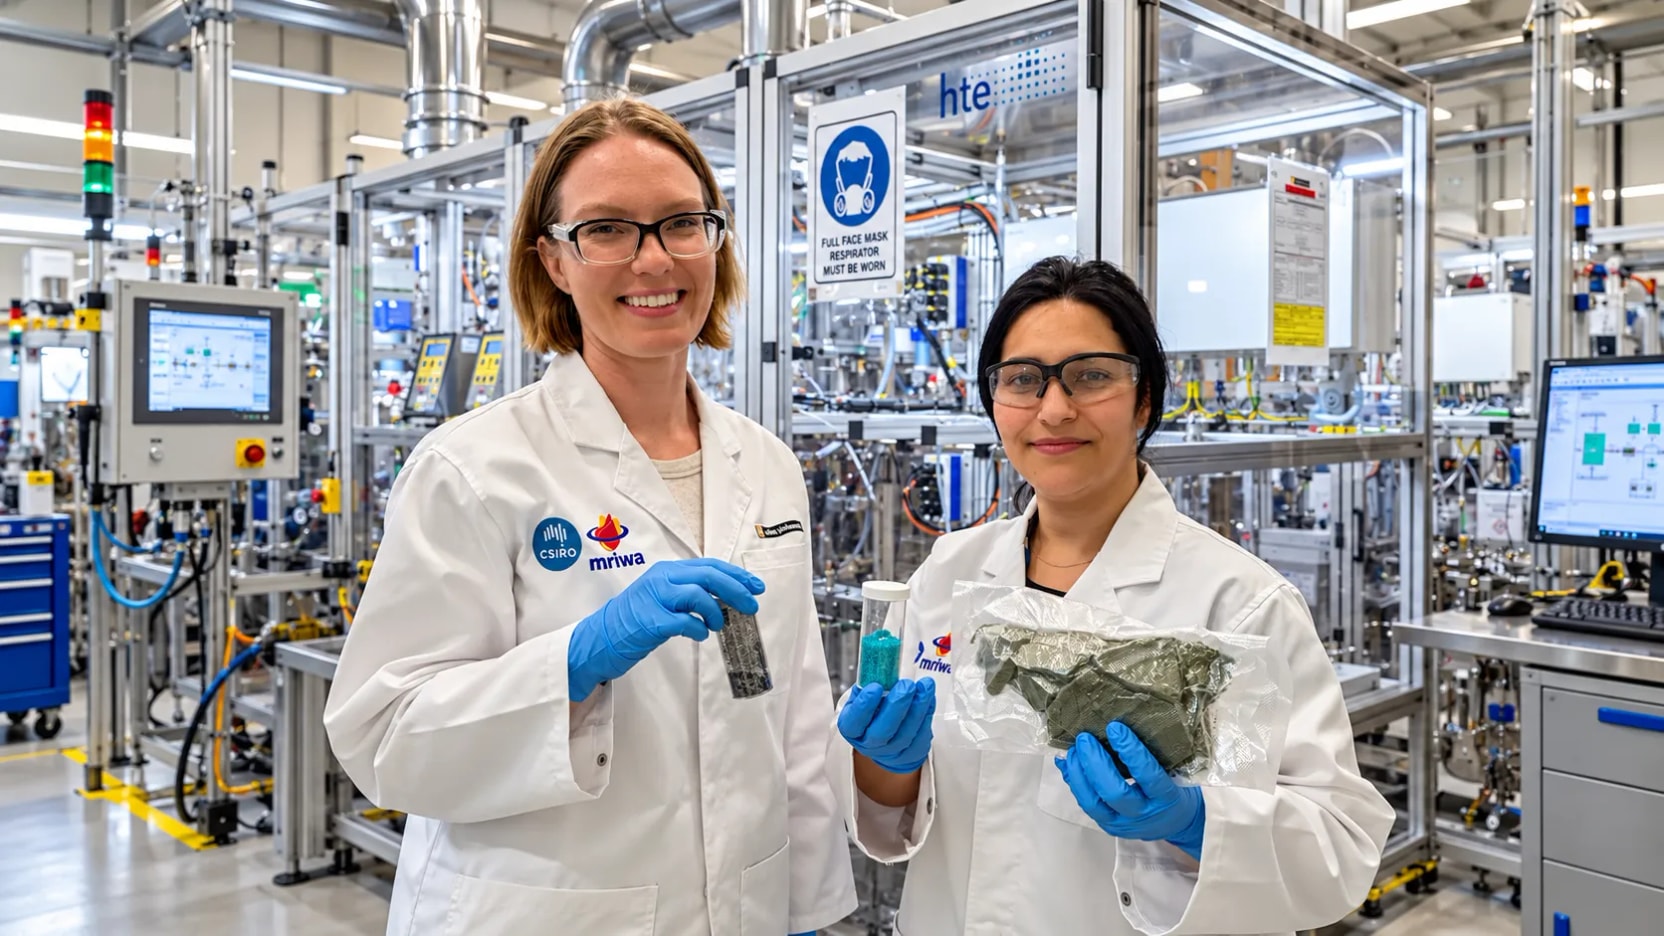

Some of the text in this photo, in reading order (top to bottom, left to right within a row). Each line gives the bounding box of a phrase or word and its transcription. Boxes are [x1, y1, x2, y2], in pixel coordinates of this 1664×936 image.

[940, 72, 991, 118] hte
[821, 231, 888, 248] FULL FACE MASK
[830, 246, 880, 261] RESPIRATOR
[823, 260, 886, 276] MUST BE WORN
[539, 548, 577, 559] CSIRO
[589, 552, 645, 571] mriwa
